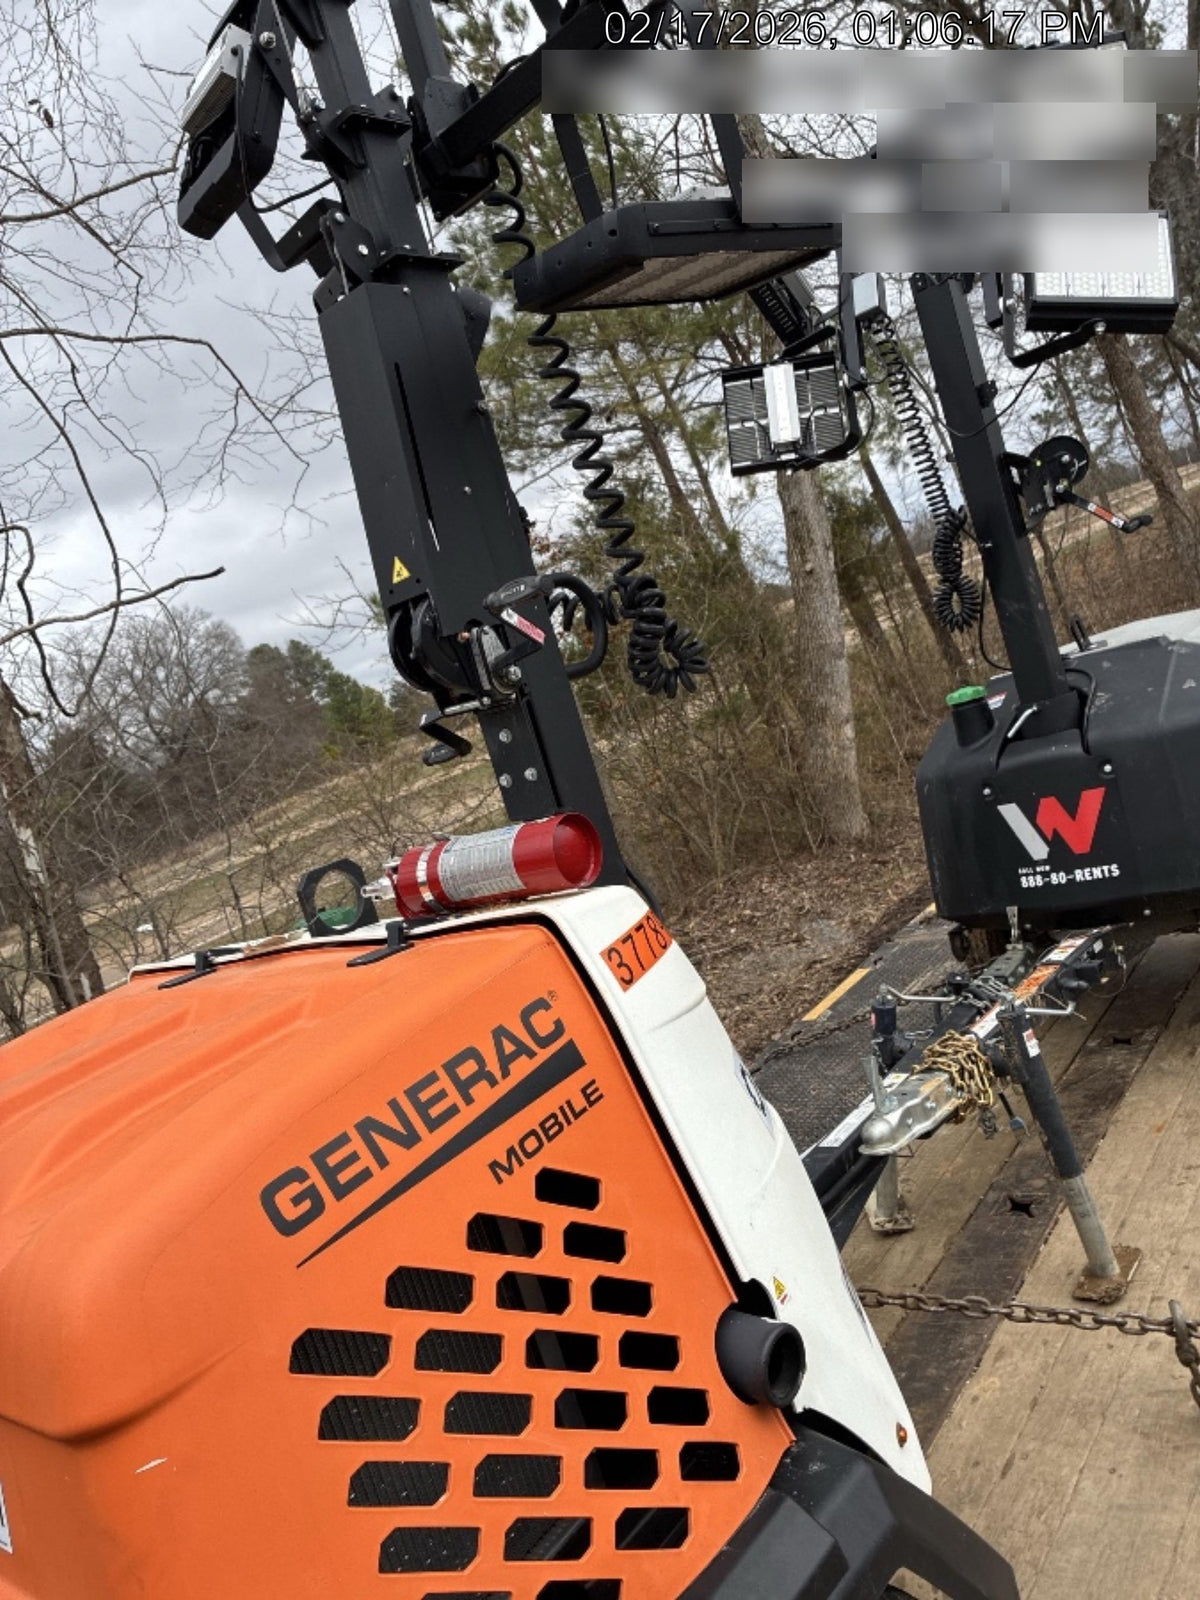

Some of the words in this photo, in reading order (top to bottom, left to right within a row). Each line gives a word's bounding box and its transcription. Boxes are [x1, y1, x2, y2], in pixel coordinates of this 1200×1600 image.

[1020, 863, 1120, 888] 888-80-RENTS
[607, 908, 669, 986] 3778
[487, 1078, 604, 1185] MOBILE
